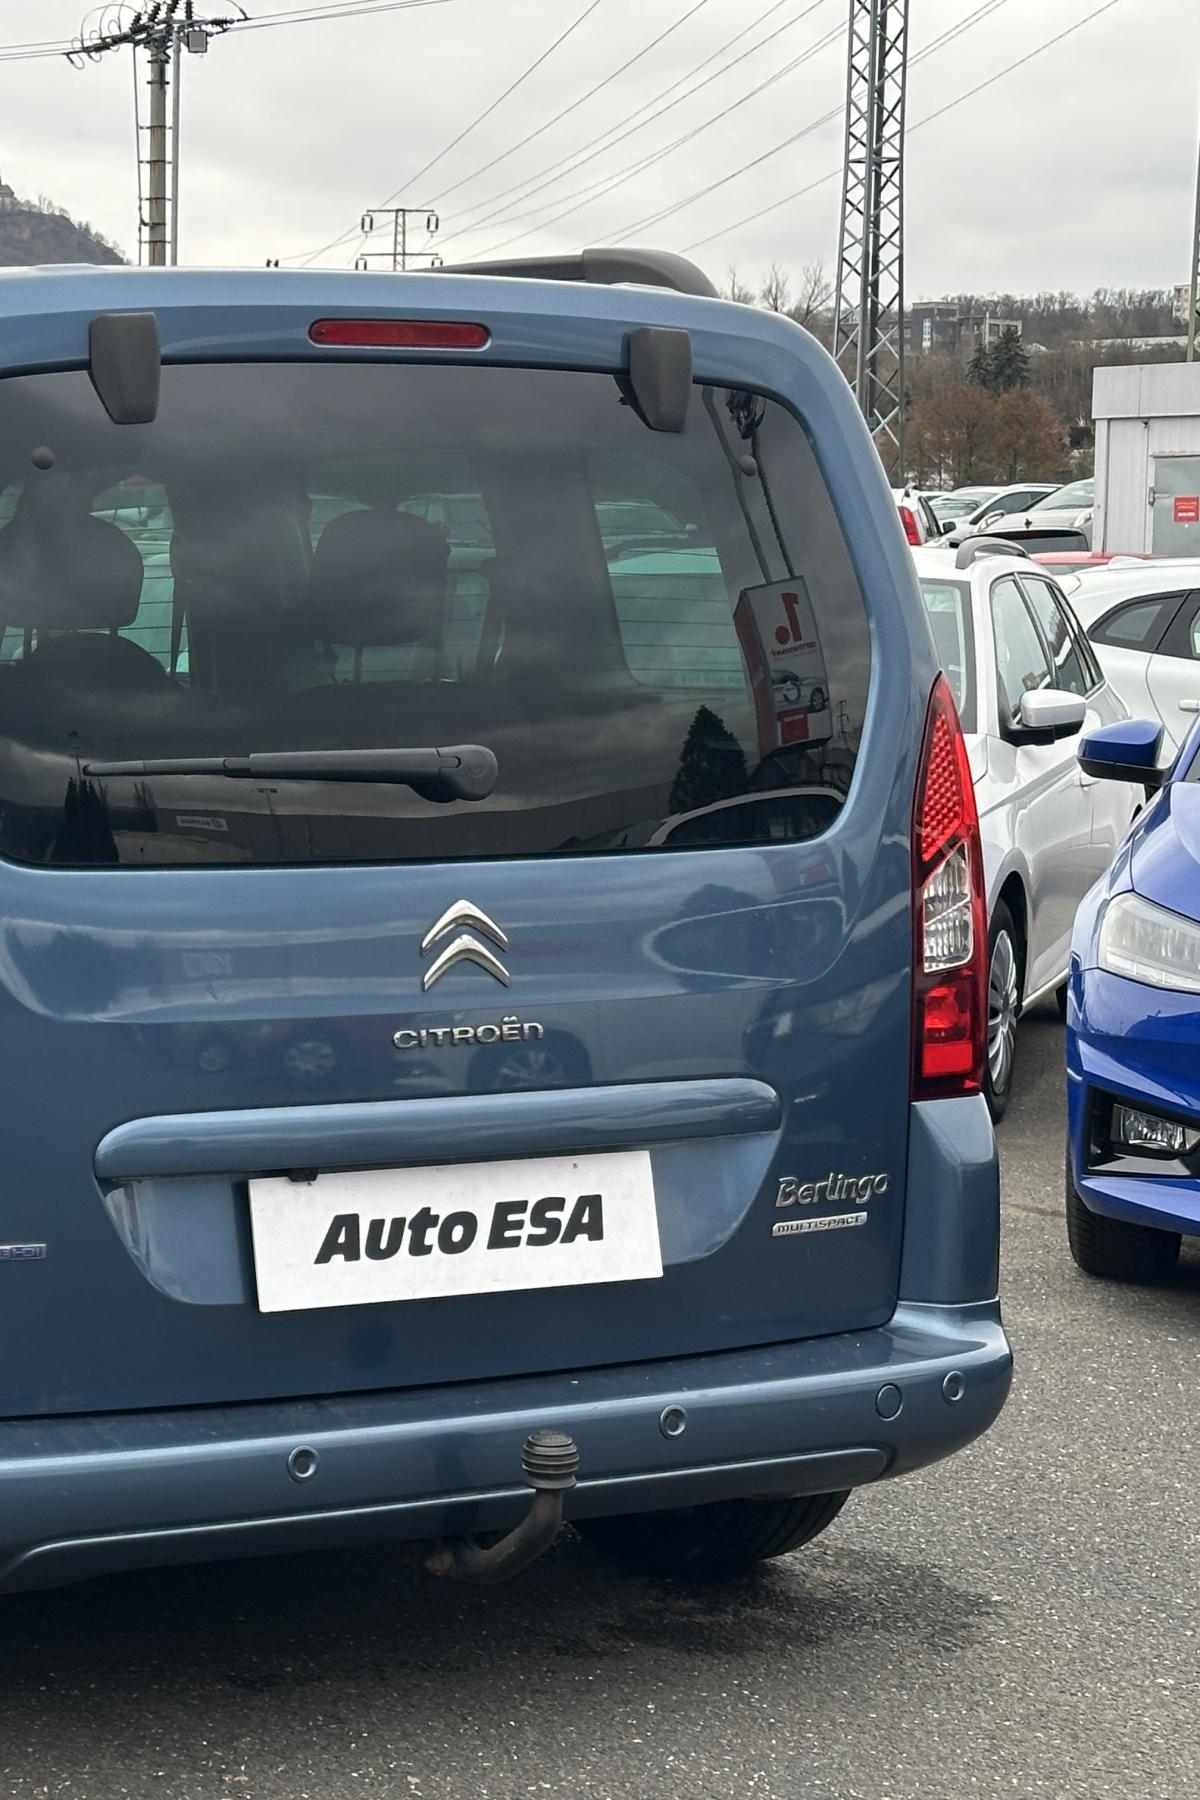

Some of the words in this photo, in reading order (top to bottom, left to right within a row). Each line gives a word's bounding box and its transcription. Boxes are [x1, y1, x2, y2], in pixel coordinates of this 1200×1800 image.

[775, 1172, 889, 1208] Berlingo
[313, 1206, 479, 1264] Auto
[486, 1193, 605, 1250] ESA
[776, 1214, 863, 1234] MULTISPACE
